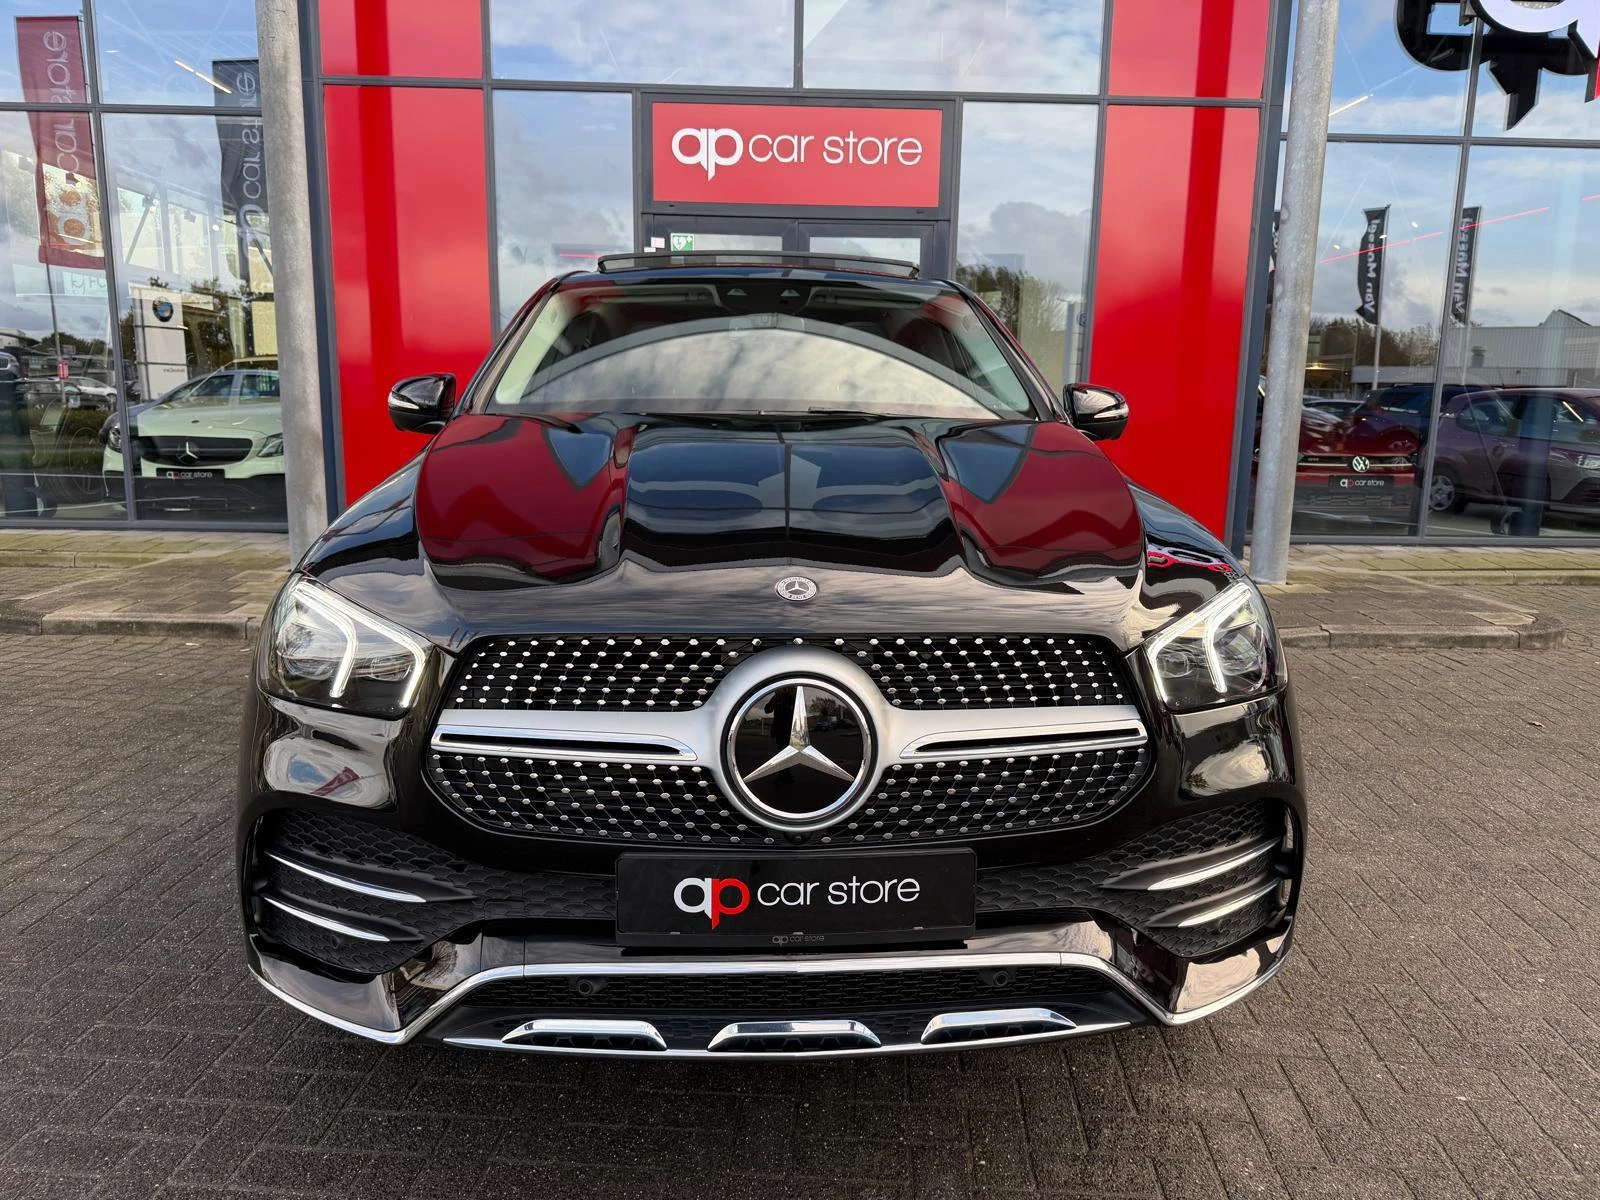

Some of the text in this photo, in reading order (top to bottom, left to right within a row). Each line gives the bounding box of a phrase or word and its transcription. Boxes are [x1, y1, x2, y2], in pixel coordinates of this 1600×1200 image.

[671, 127, 923, 182] ap car store
[673, 875, 921, 930] ap car store
